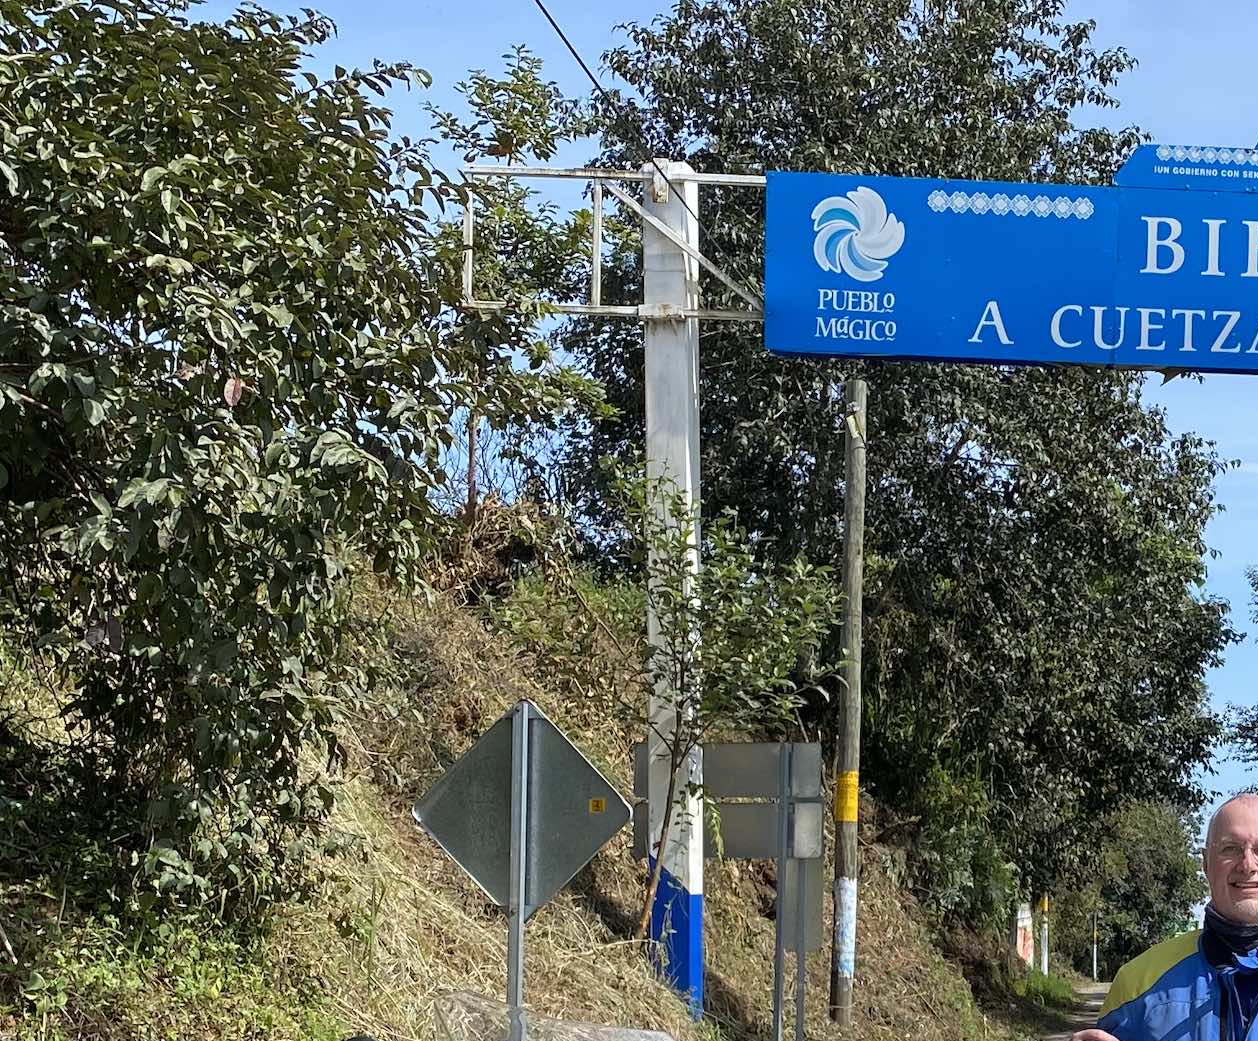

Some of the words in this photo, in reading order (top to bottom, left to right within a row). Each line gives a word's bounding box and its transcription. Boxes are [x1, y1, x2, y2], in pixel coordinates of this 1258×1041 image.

[1172, 166, 1218, 177] GOBIERNO
[1220, 169, 1240, 178] CON
[967, 301, 1015, 345] A
